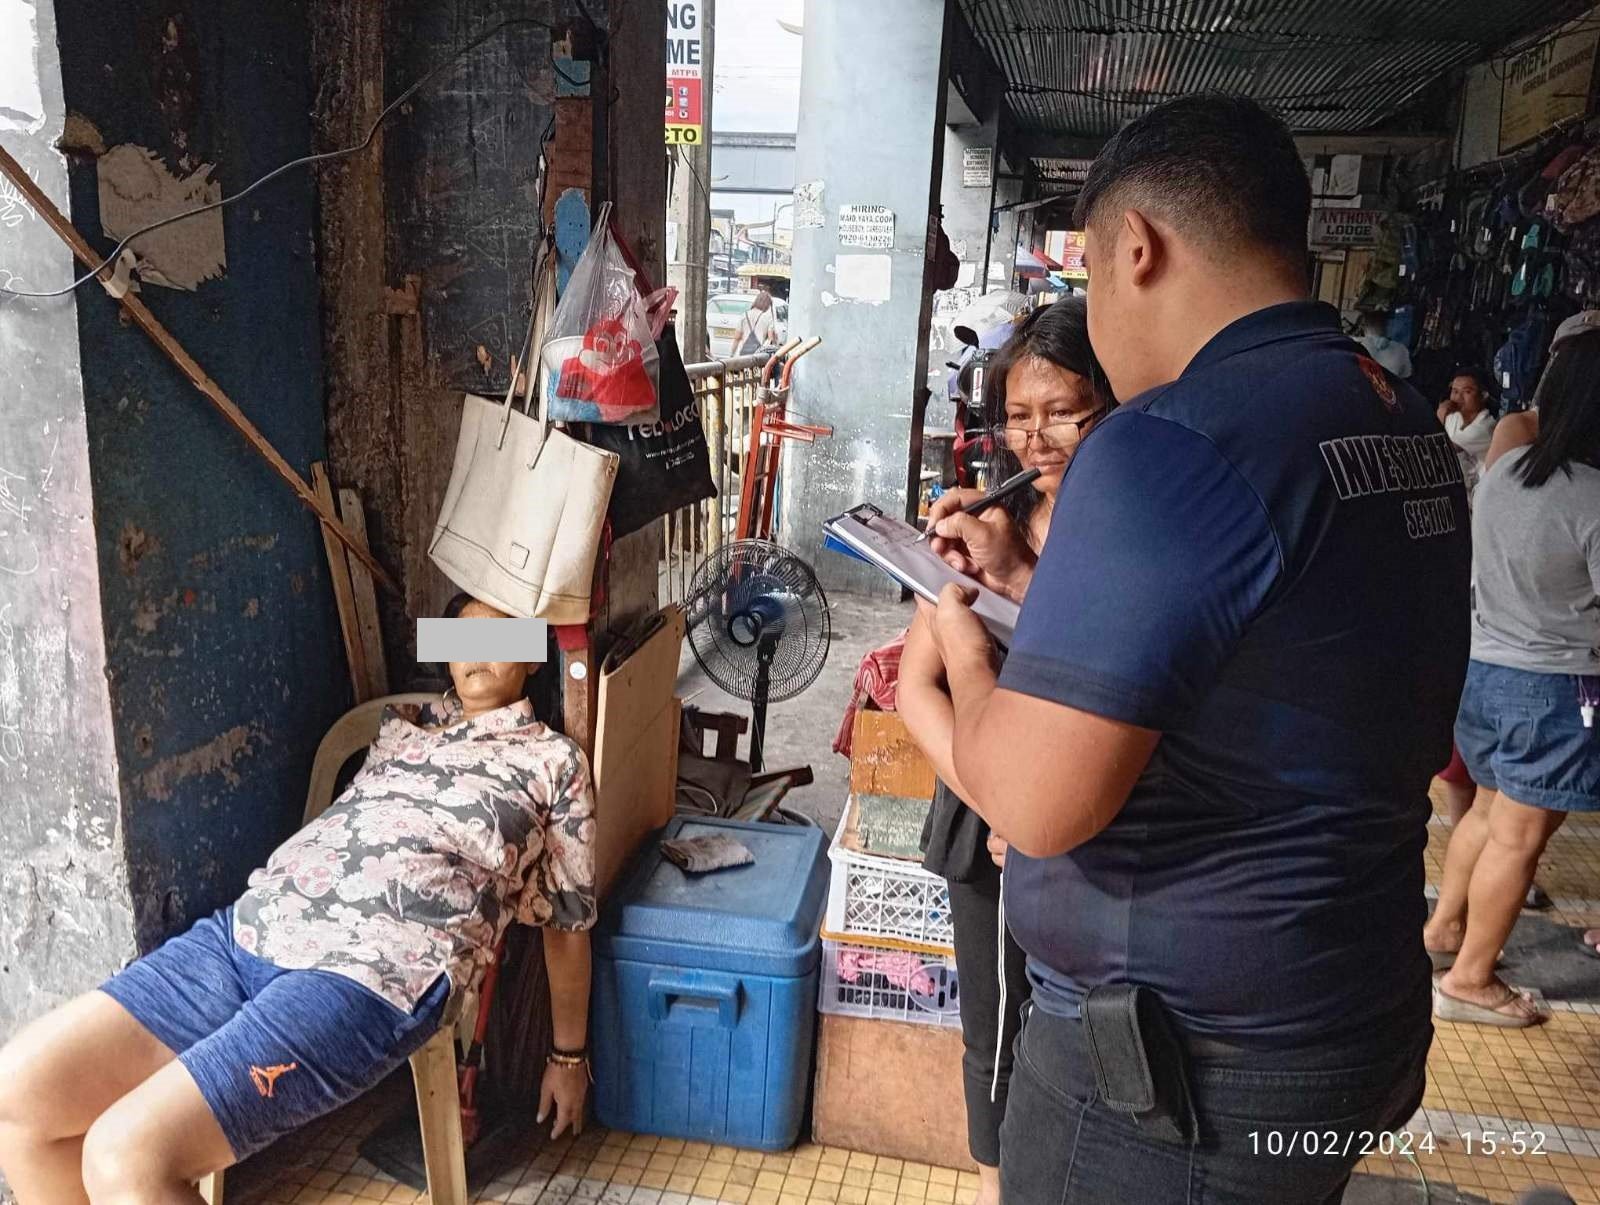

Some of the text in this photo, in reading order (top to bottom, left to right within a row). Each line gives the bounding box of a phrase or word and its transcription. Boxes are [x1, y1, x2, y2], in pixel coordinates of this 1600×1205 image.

[851, 204, 886, 214] HIRING
[1319, 210, 1382, 225] ANTHONY
[1326, 225, 1372, 236] LODGE
[1403, 496, 1456, 539] SECTION
